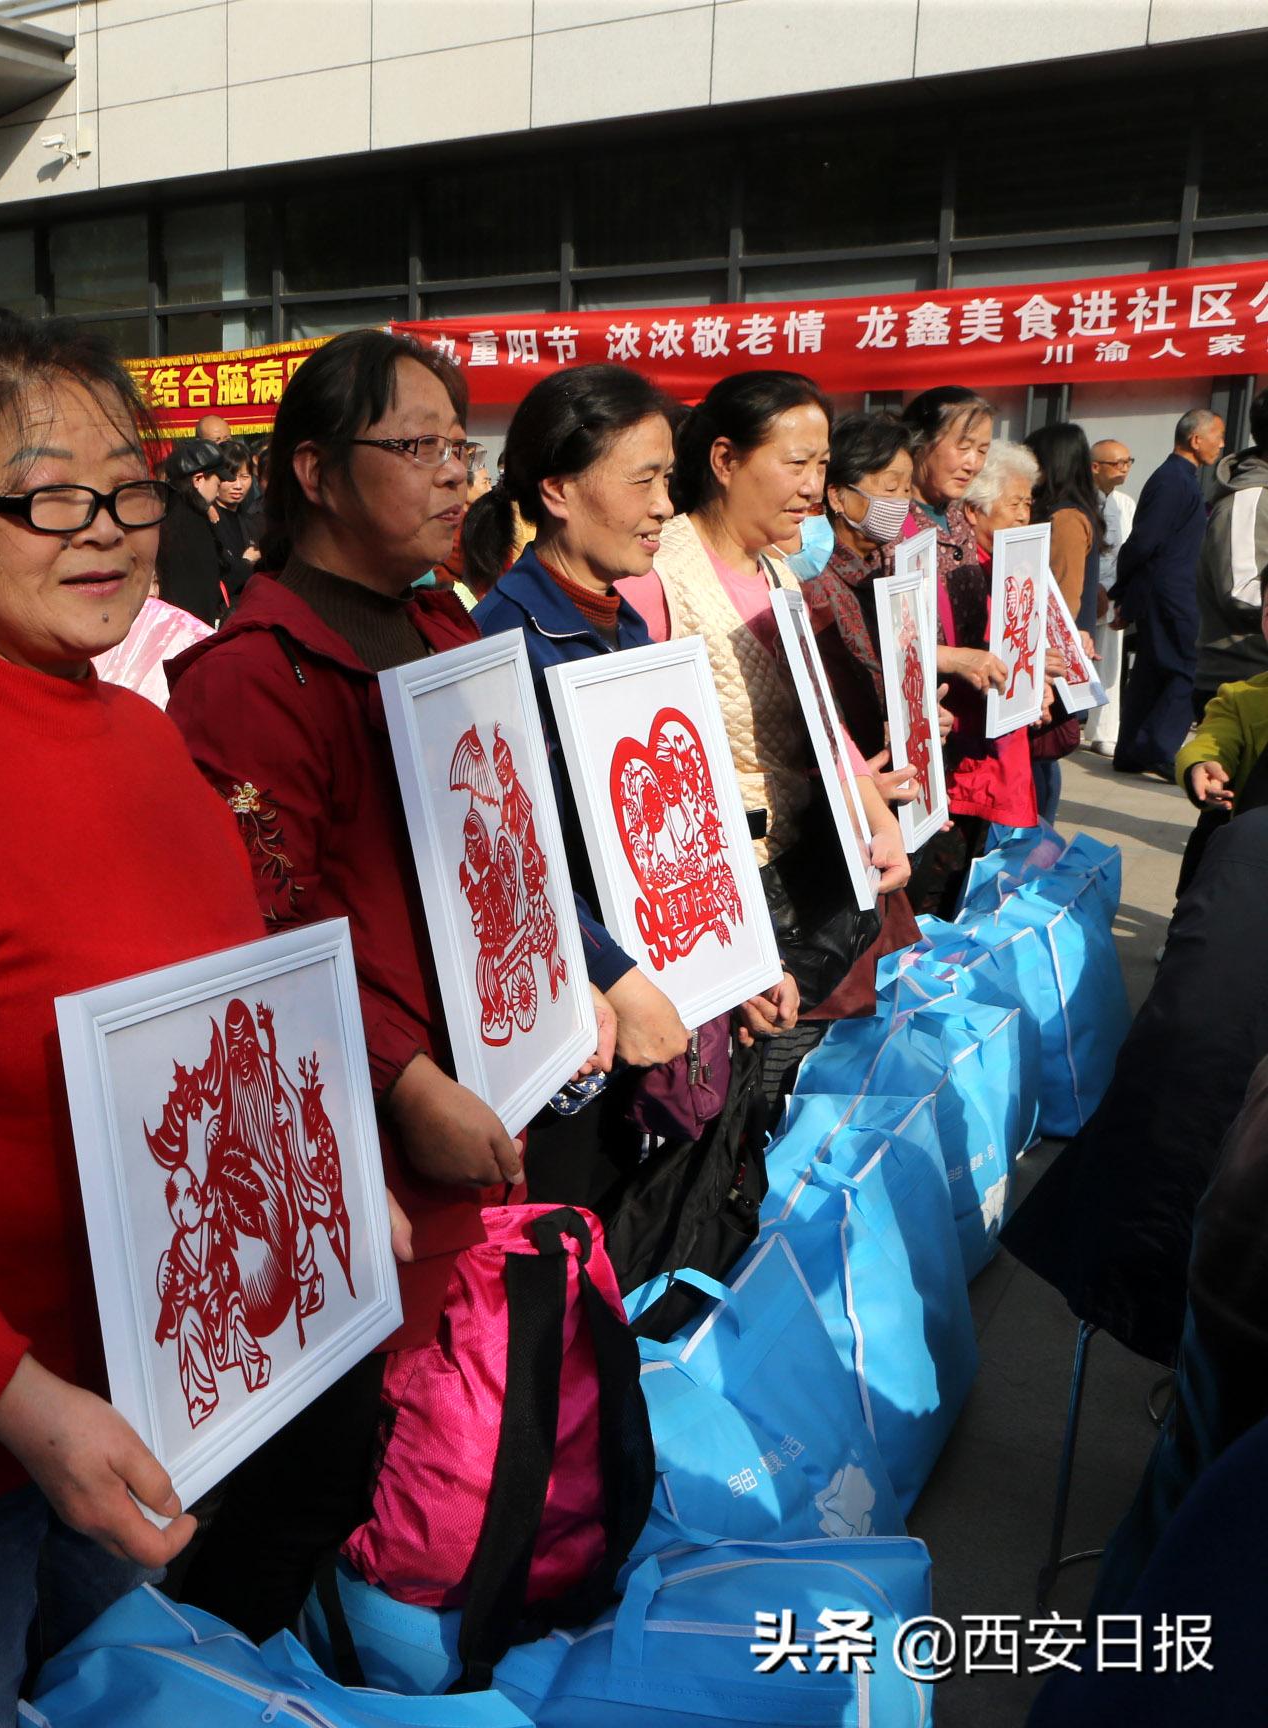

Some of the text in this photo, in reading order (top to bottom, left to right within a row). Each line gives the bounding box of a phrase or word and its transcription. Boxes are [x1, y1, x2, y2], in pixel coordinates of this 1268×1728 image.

[406, 325, 579, 368] 九重阳节
[604, 310, 826, 362] 浓浓敬老情
[1040, 331, 1268, 366] 川渝人家
